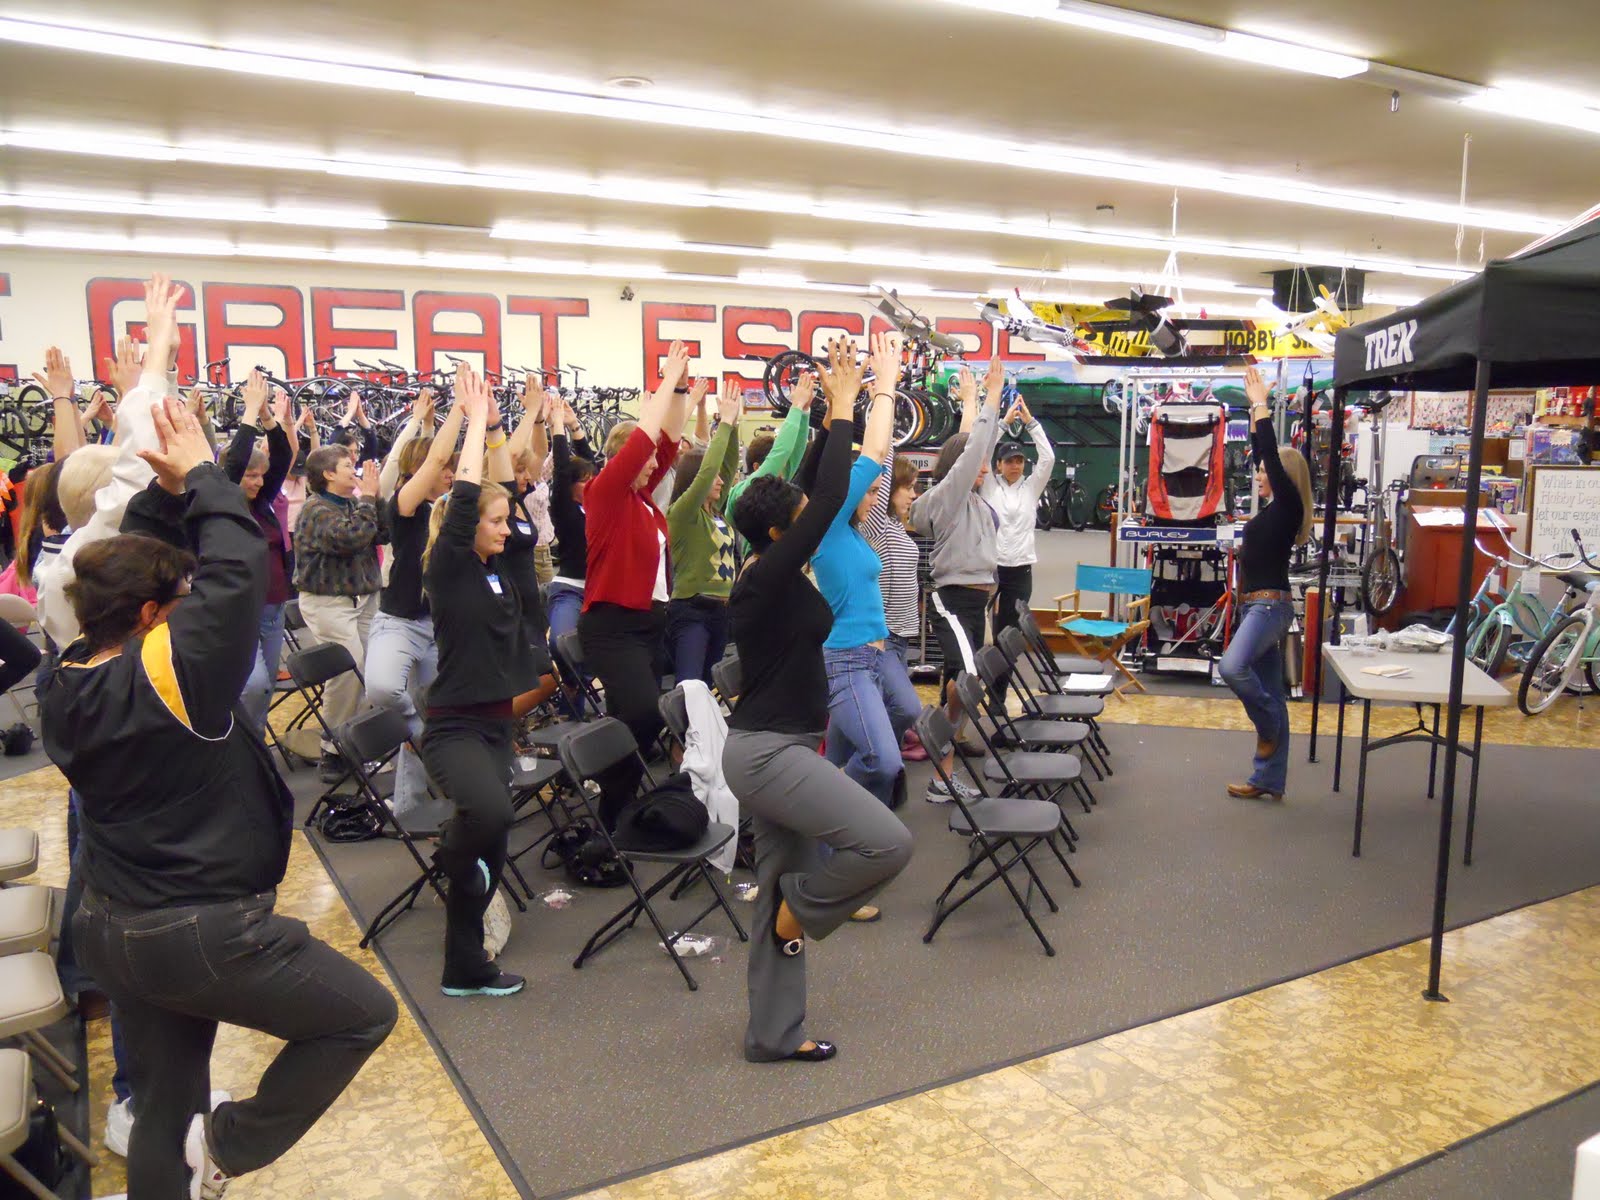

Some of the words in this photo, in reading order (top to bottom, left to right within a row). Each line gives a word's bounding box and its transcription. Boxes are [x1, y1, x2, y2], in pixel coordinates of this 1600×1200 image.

[86, 276, 590, 387] GREAT
[1224, 329, 1276, 351] HOBBY
[1364, 319, 1418, 371] TREK
[1125, 530, 1190, 538] BURLEY
